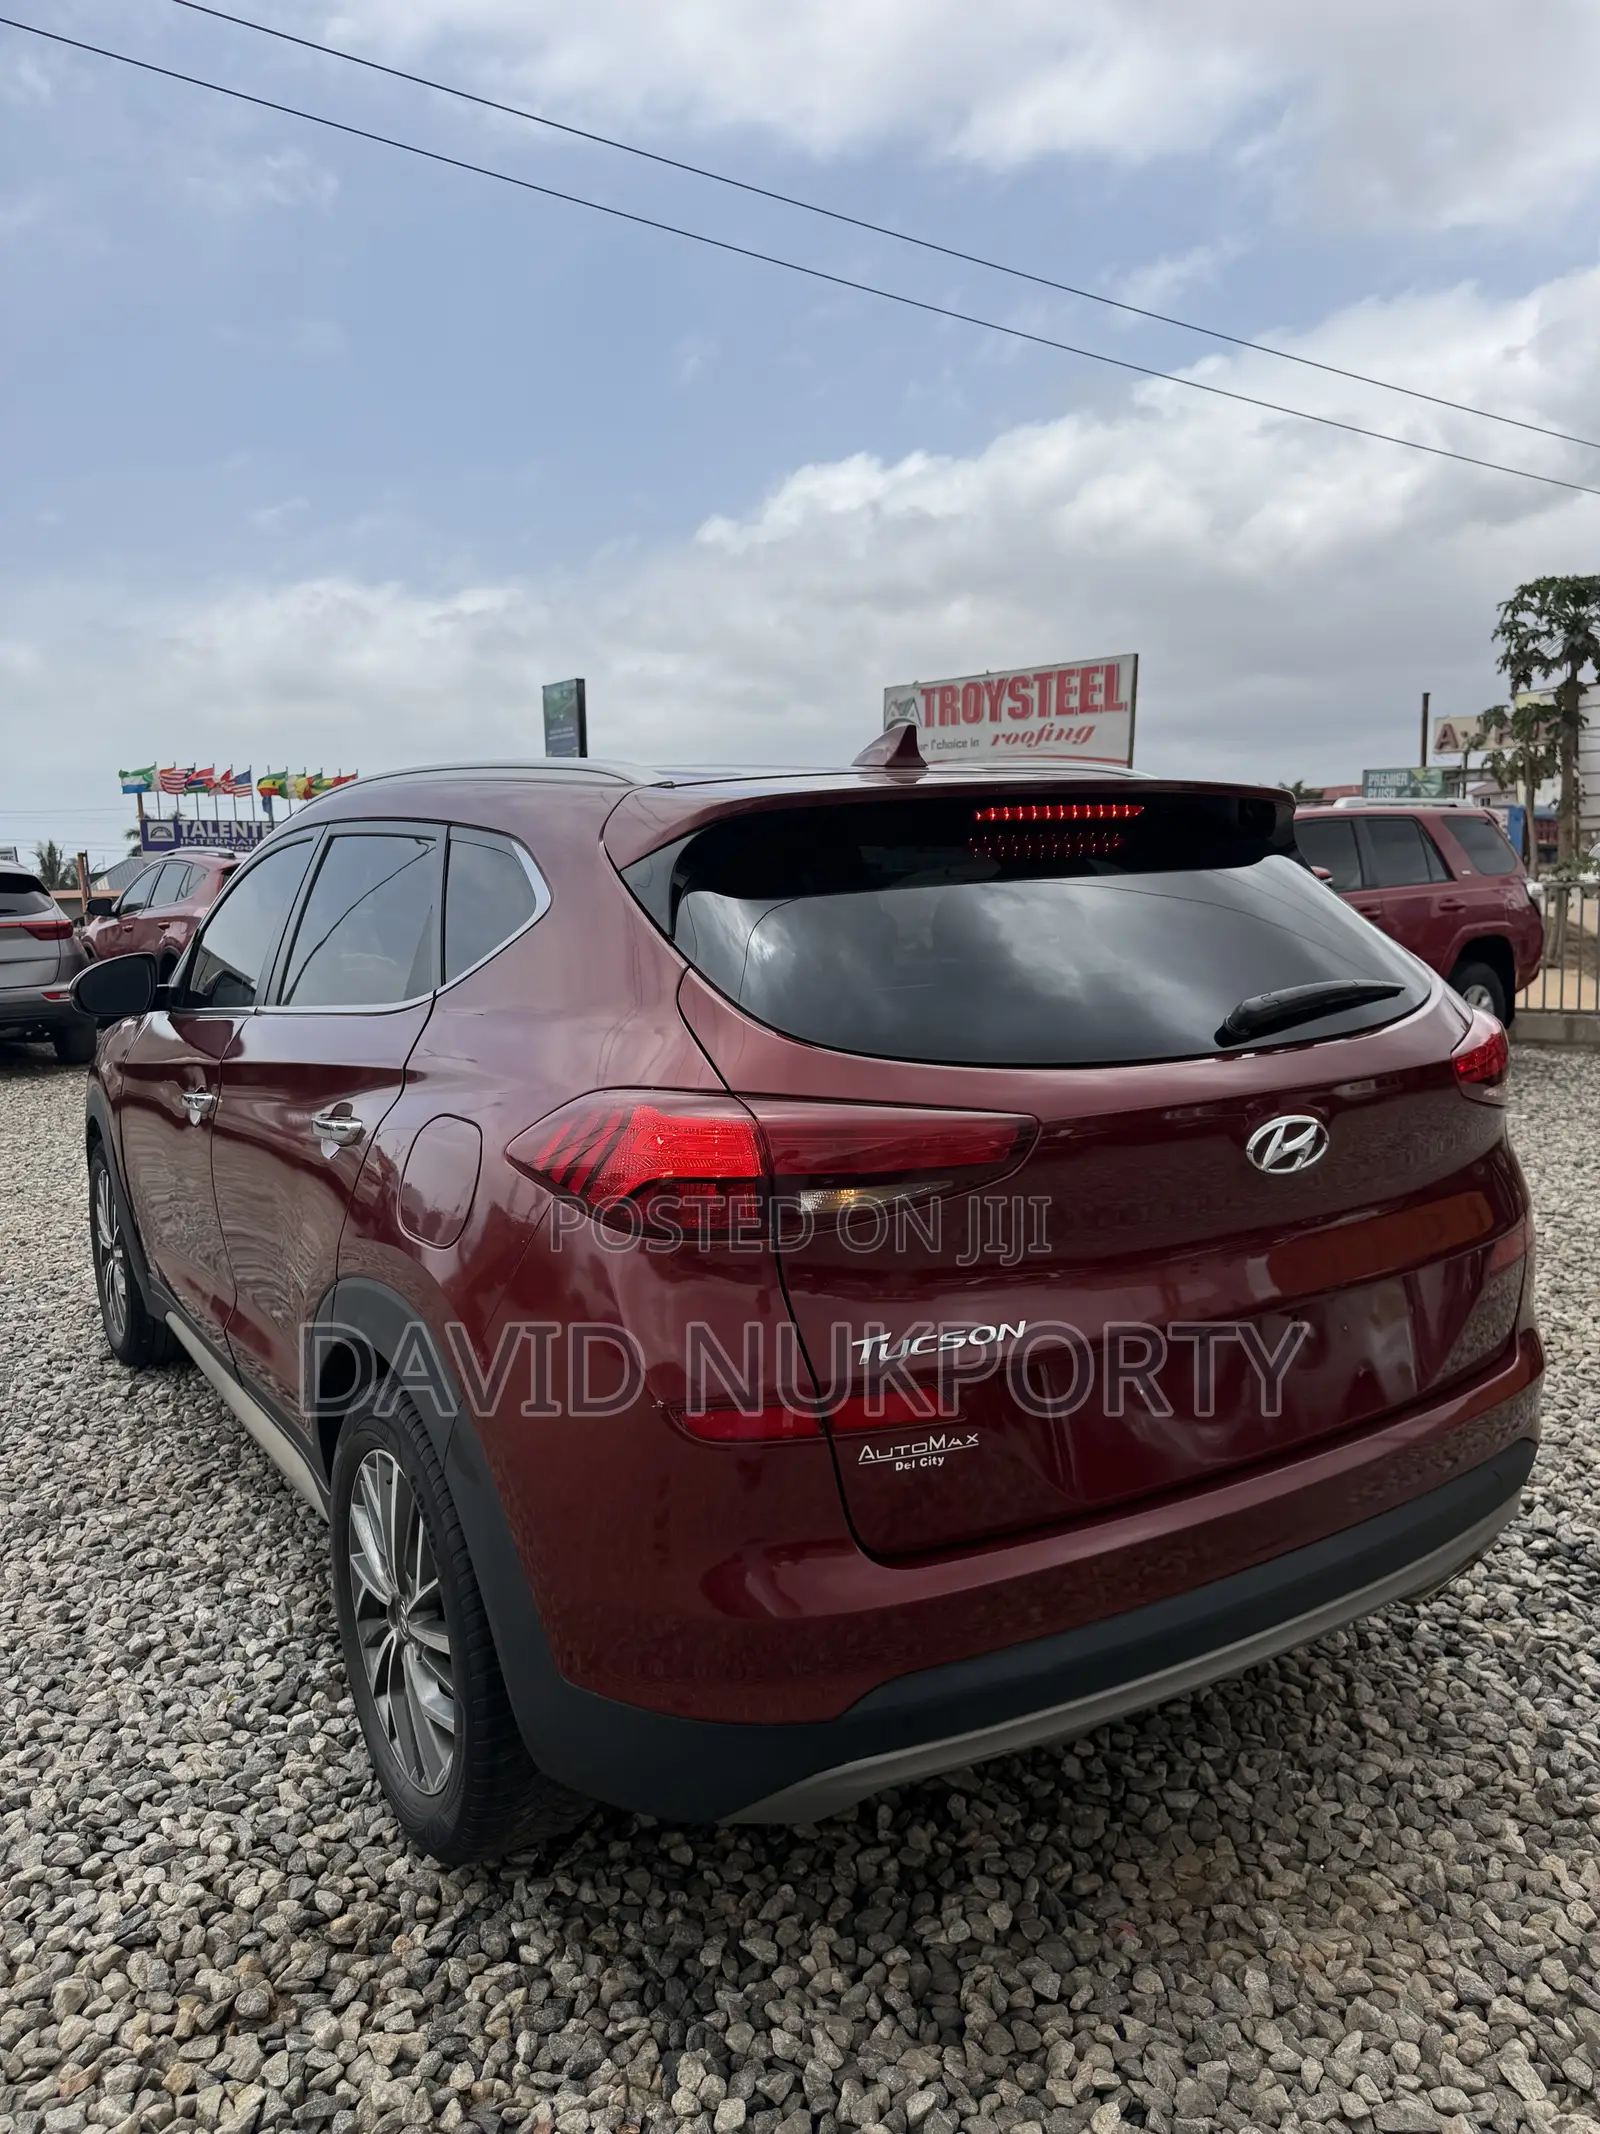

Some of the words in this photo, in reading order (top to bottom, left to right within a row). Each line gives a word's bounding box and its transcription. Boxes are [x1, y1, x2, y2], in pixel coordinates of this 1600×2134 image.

[921, 663, 1127, 728] TROYSTEEL
[990, 722, 1096, 749] roofing
[1368, 772, 1408, 787] PREMIER
[895, 1461, 915, 1472] Del
[919, 1456, 945, 1469] City
